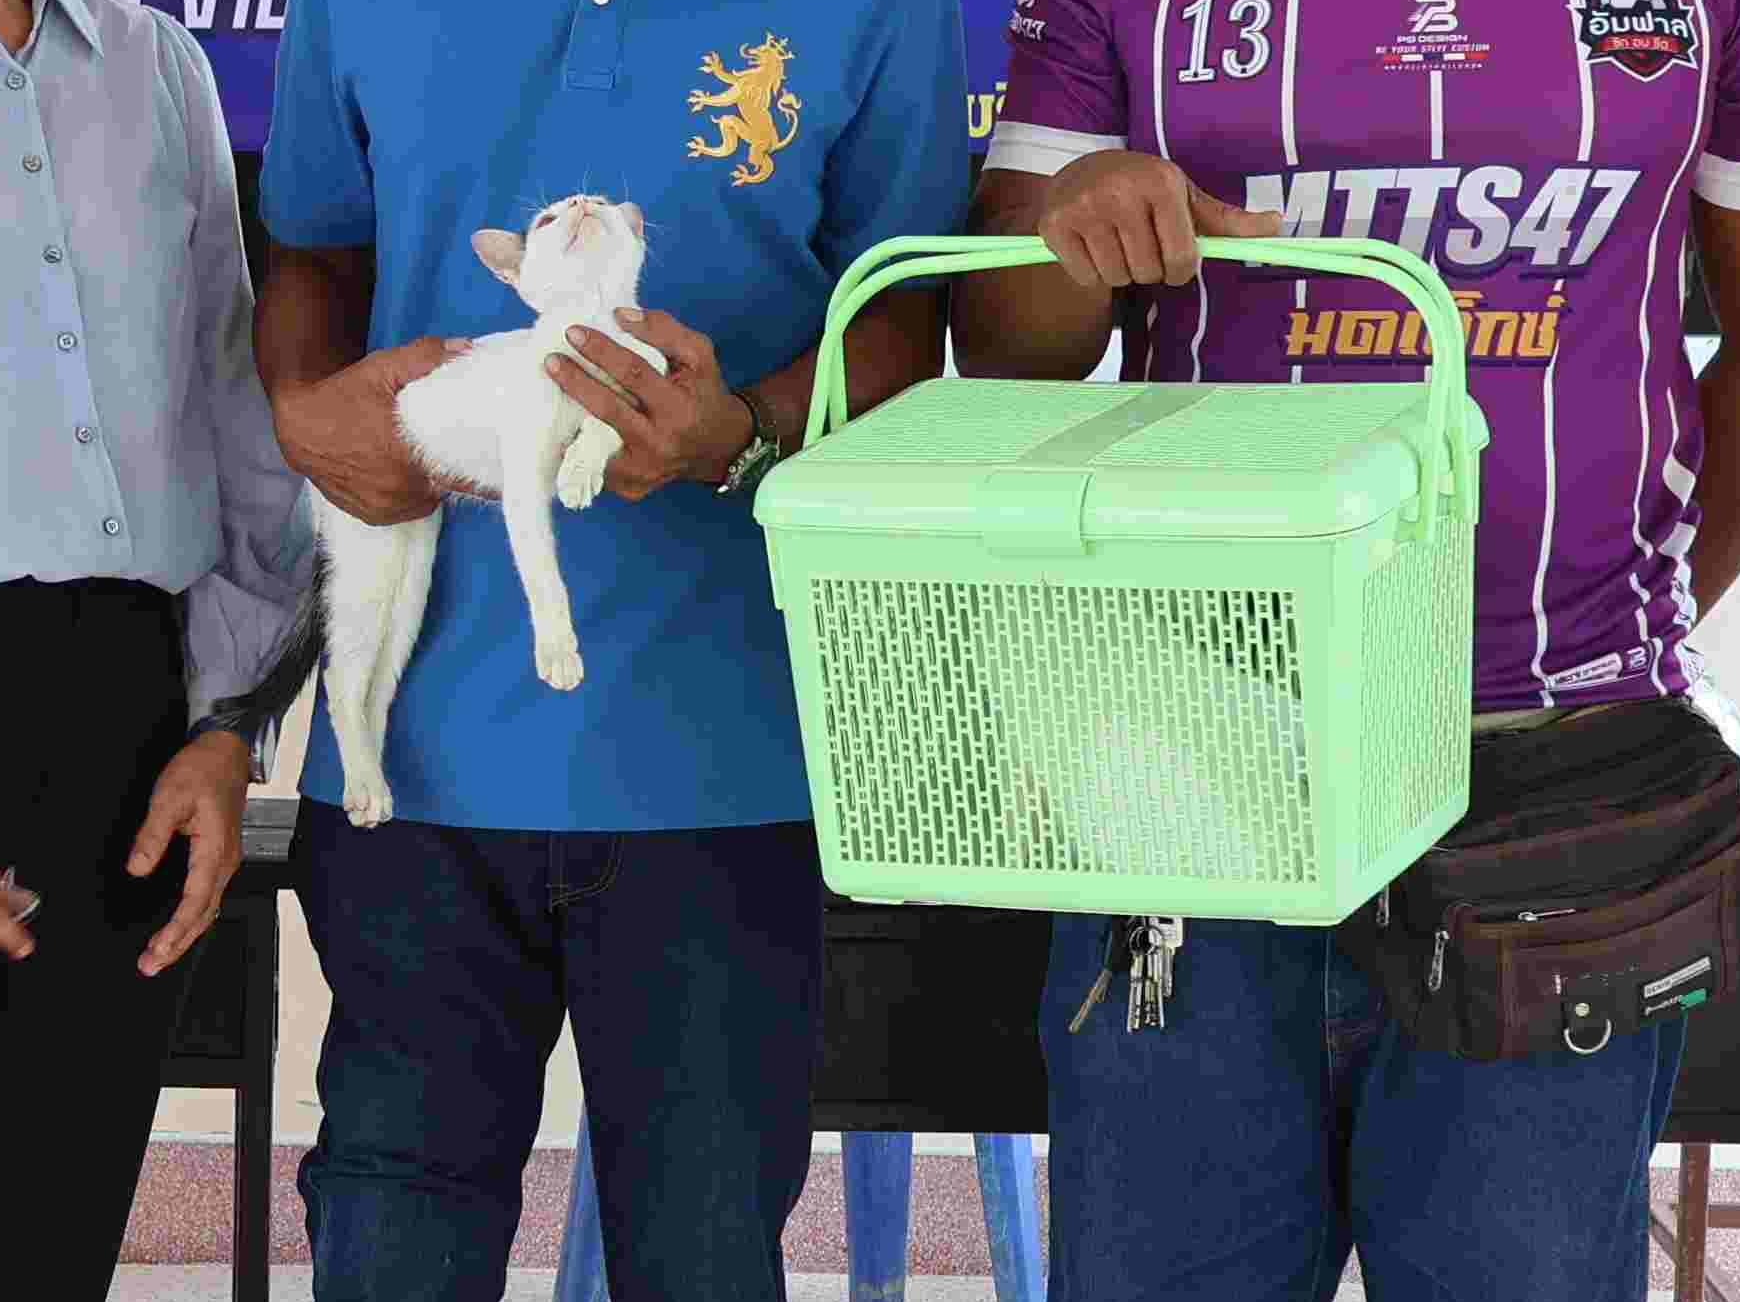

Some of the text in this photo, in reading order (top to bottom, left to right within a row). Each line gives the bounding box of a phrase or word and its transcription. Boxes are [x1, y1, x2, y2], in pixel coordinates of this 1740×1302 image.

[1588, 10, 1689, 39] อัมฟาล
[1245, 164, 1643, 268] MTTS47
